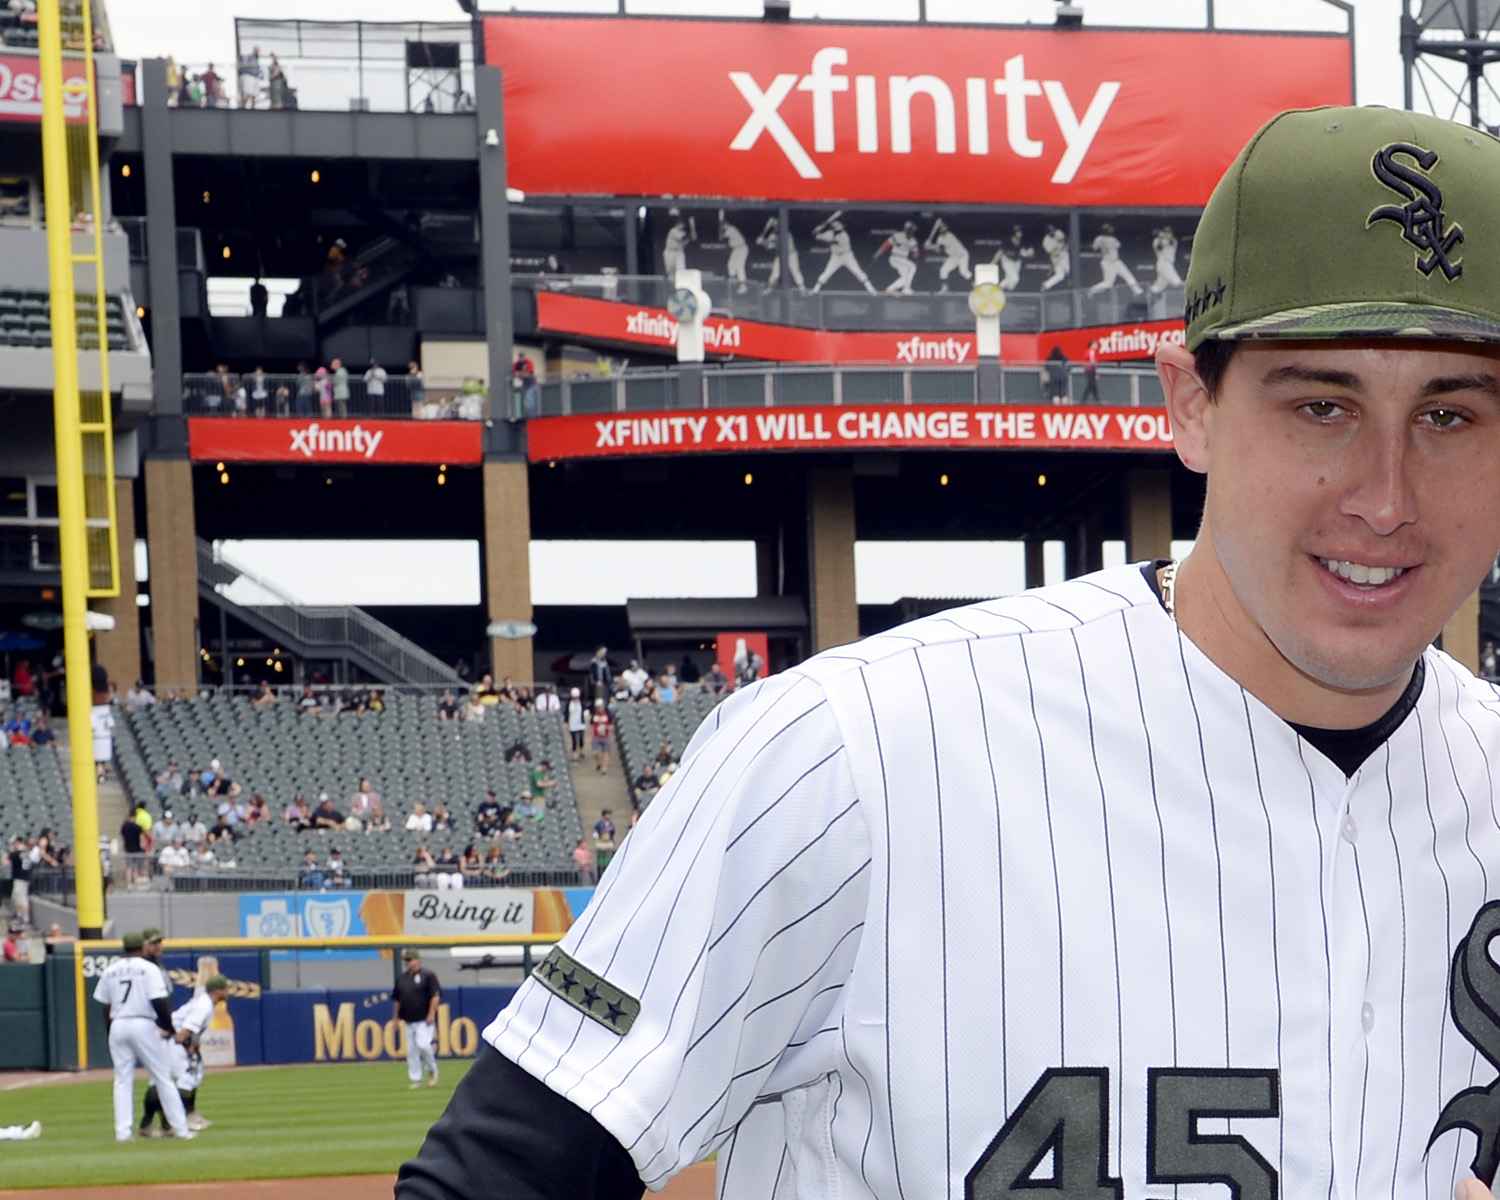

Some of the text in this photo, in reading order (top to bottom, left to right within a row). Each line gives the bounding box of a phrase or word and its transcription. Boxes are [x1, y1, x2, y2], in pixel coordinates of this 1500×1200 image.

[728, 46, 1121, 184] xfinity
[896, 336, 971, 364] xfinity
[1099, 328, 1186, 355] xfinity.co
[289, 424, 384, 457] xfinity
[596, 416, 709, 448] XFINITY
[715, 415, 748, 443] X1
[755, 413, 832, 441] WILL
[837, 410, 968, 441] CHANGE
[977, 411, 1035, 440] THE
[1042, 412, 1110, 441] WAY
[411, 894, 526, 935] Bring it
[118, 979, 133, 1004] 7
